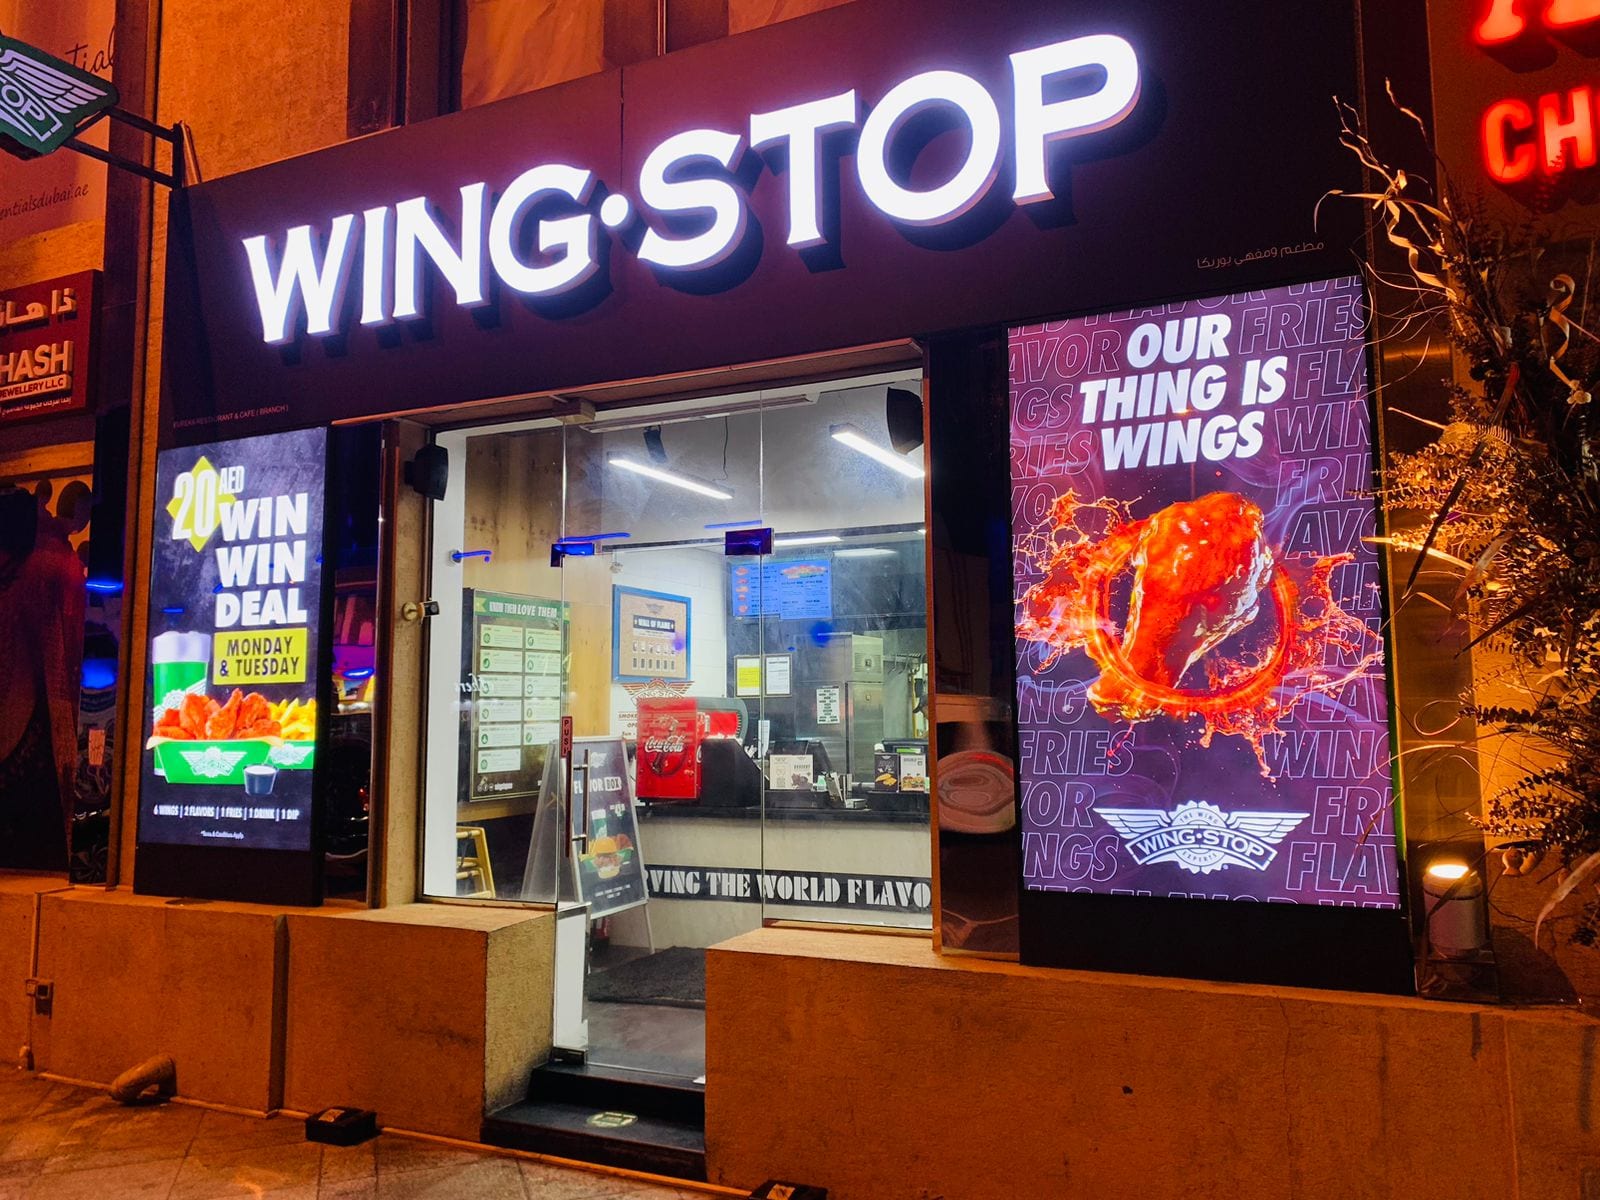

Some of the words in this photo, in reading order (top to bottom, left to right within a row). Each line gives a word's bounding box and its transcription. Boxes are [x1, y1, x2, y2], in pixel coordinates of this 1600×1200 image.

[0, 75, 46, 122] OP
[1480, 84, 1600, 184] CH
[1280, 241, 1325, 258] مطعم
[1127, 313, 1232, 369] OUR
[1079, 364, 1227, 424] THING
[1241, 355, 1289, 406] IS
[1101, 411, 1265, 471] WINGS
[172, 469, 218, 540] 20
[219, 465, 245, 494] AED
[218, 492, 308, 541] WIN
[215, 540, 306, 588] WIN
[215, 588, 307, 628] DEAL
[518, 604, 537, 617] LOVE
[219, 660, 230, 677] &
[236, 656, 300, 677] TUESDAY
[226, 636, 293, 657] MONDAY
[1018, 730, 1136, 776] FRIES
[159, 804, 179, 816] WINGS
[190, 805, 215, 818] FLAVORS
[225, 807, 243, 818] FRIES
[254, 808, 275, 820] DRINK
[286, 808, 300, 821] DIP
[1179, 811, 1195, 824] THE
[1197, 811, 1218, 825] WING
[1181, 850, 1218, 864] EXPERTS
[705, 871, 751, 897] THE
[757, 873, 841, 903] WORLD
